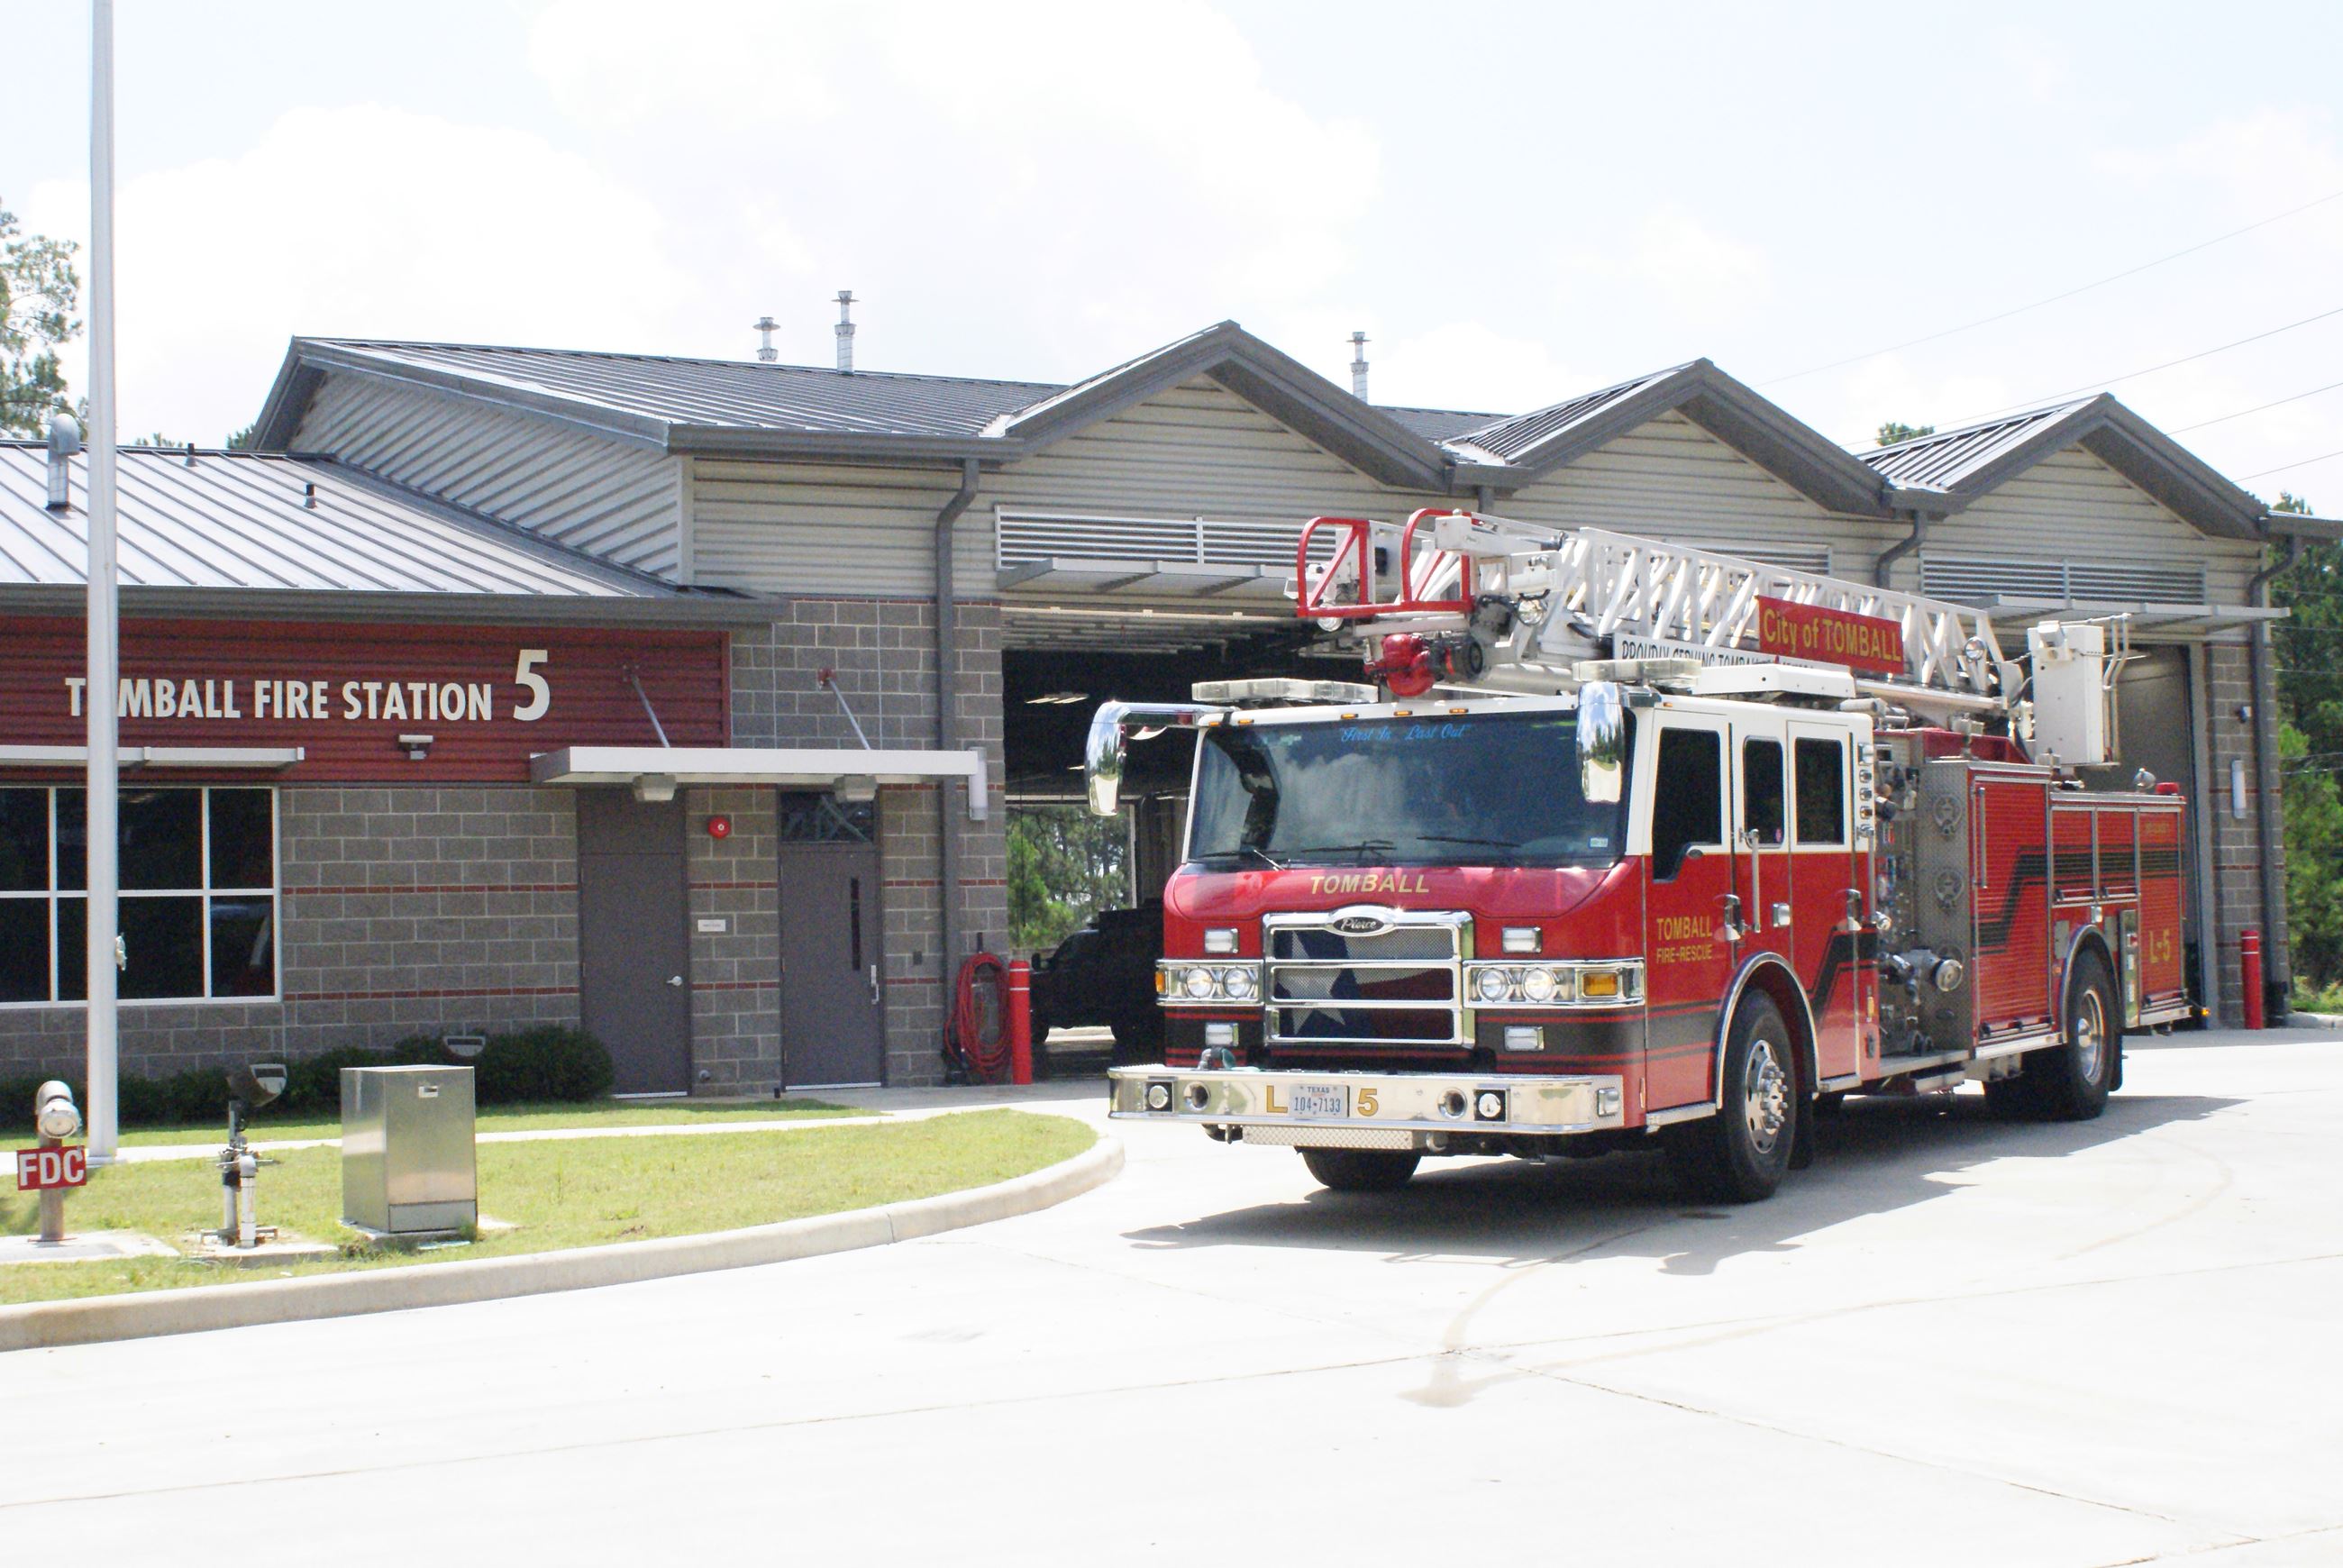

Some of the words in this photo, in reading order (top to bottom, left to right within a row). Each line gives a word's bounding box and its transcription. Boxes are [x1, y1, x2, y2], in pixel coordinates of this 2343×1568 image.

[1764, 607, 1798, 655] City
[1803, 617, 1819, 649] of
[1822, 618, 1902, 662] TOMBALL
[65, 677, 242, 718] TMBALL
[254, 679, 329, 719] FIRE
[342, 680, 492, 721] STATION
[513, 649, 551, 722] 5
[1404, 724, 1438, 741] Last
[1310, 873, 1430, 895] TOMBALL
[1656, 916, 1713, 941] TOMBALL
[1656, 944, 1713, 964] FIRE-RESCUE
[2148, 928, 2171, 964] L-5
[1266, 1085, 1289, 1114] L
[1357, 1088, 1380, 1117] 5
[1307, 1086, 1330, 1094] TEXAS
[18, 1149, 85, 1187] FDC
